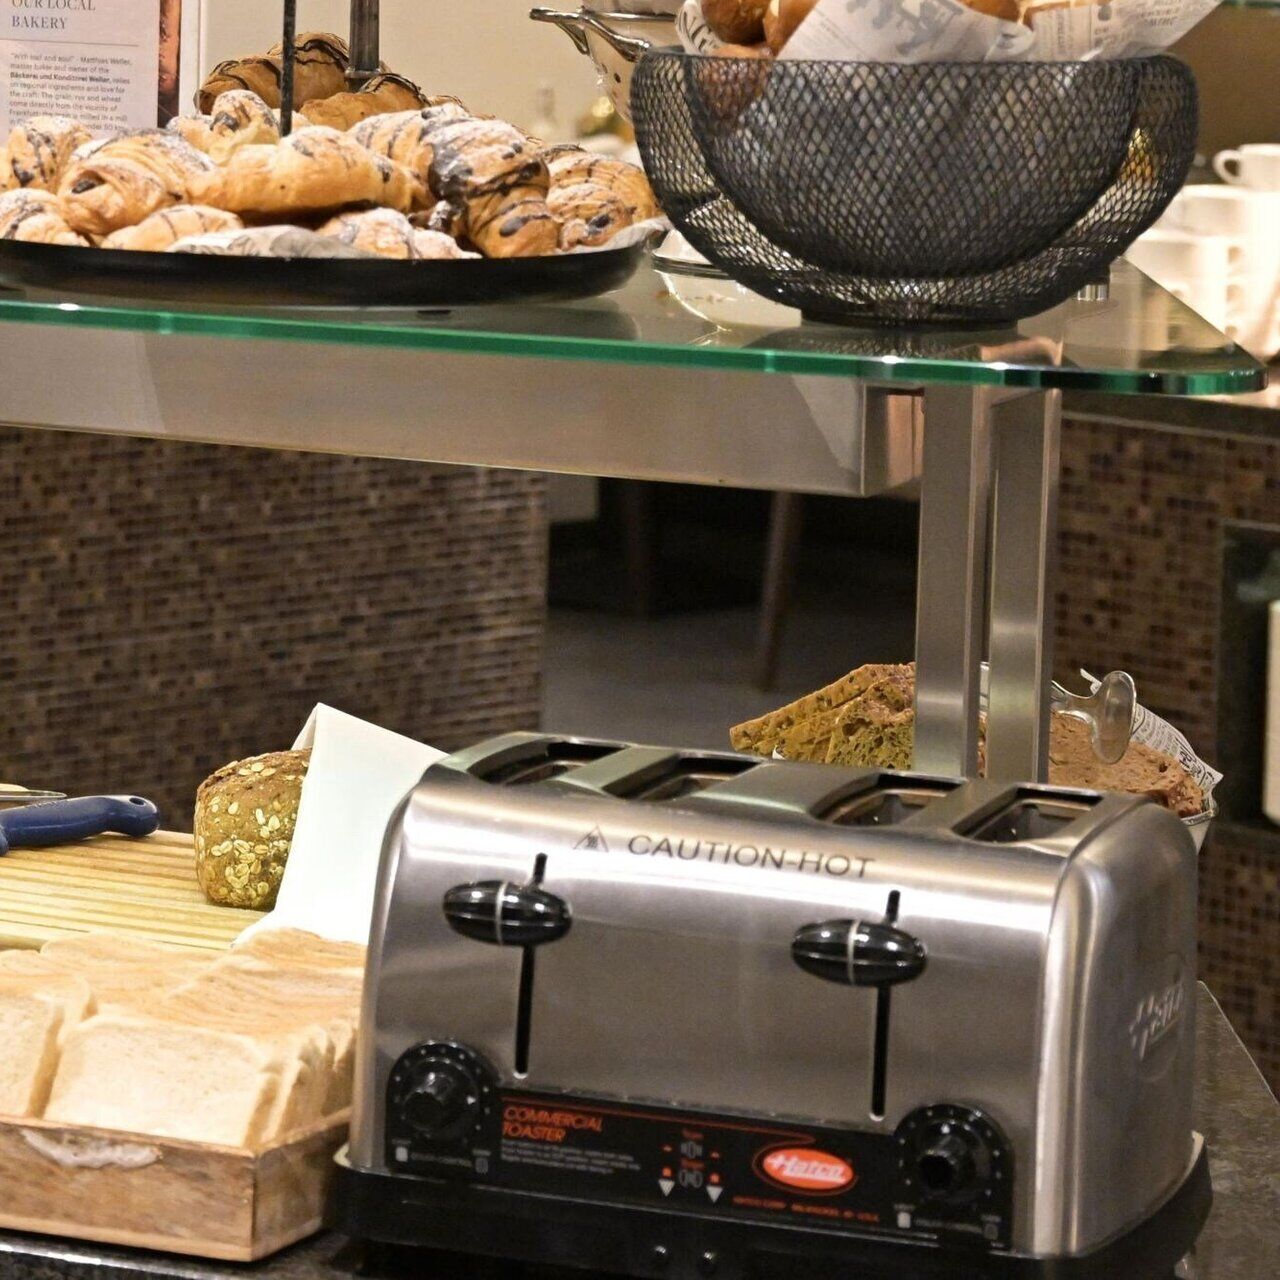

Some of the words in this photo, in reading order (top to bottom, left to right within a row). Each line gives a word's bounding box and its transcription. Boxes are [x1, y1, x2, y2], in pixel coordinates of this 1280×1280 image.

[12, 15, 68, 29] BAKERY
[628, 834, 877, 879] CAUTION-HOT
[503, 1107, 602, 1132] COMMERCIAL
[503, 1121, 566, 1143] TOASTER
[768, 1153, 848, 1185] Hatco
